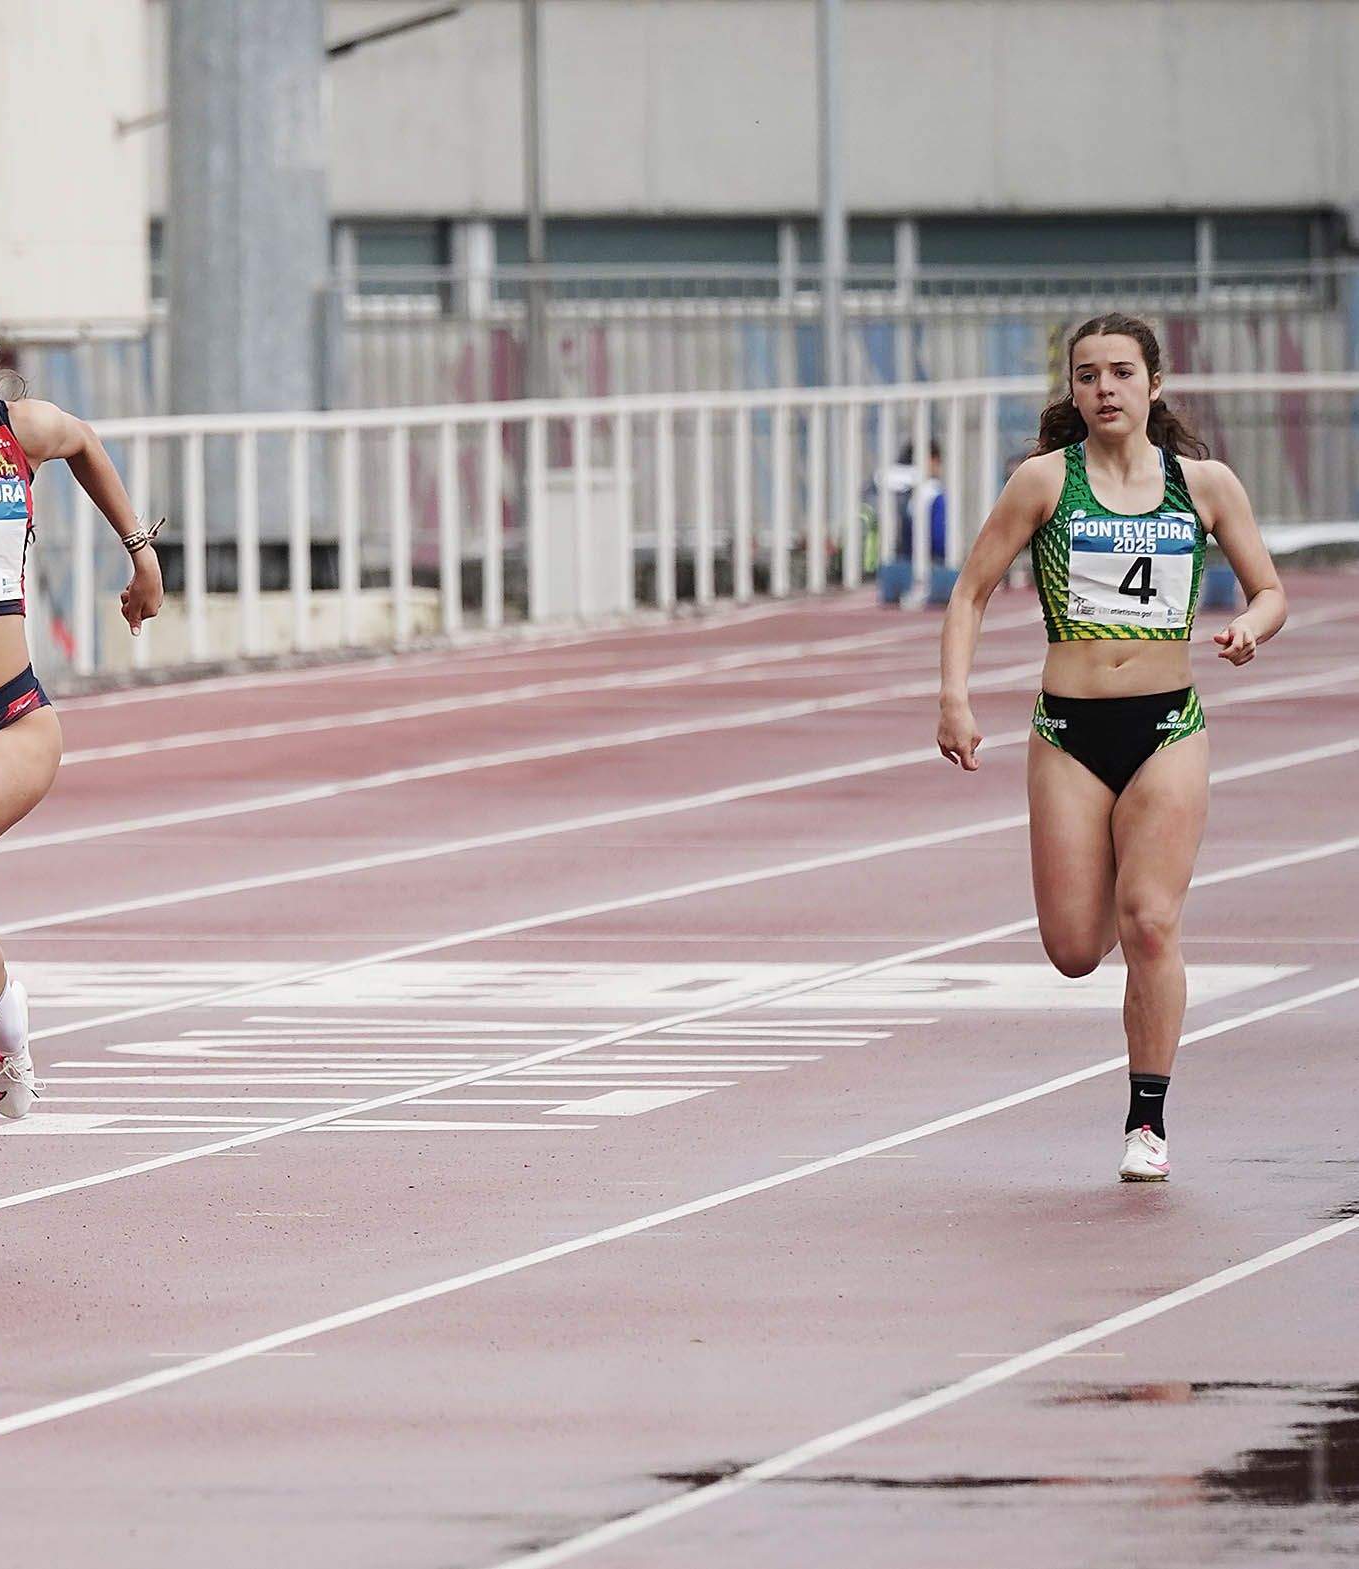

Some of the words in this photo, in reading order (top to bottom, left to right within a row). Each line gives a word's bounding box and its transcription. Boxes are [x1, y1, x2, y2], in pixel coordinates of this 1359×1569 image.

[1073, 521, 1193, 540] PONTEVEDRA
[1113, 538, 1157, 554] 2025
[1118, 556, 1157, 605] 4
